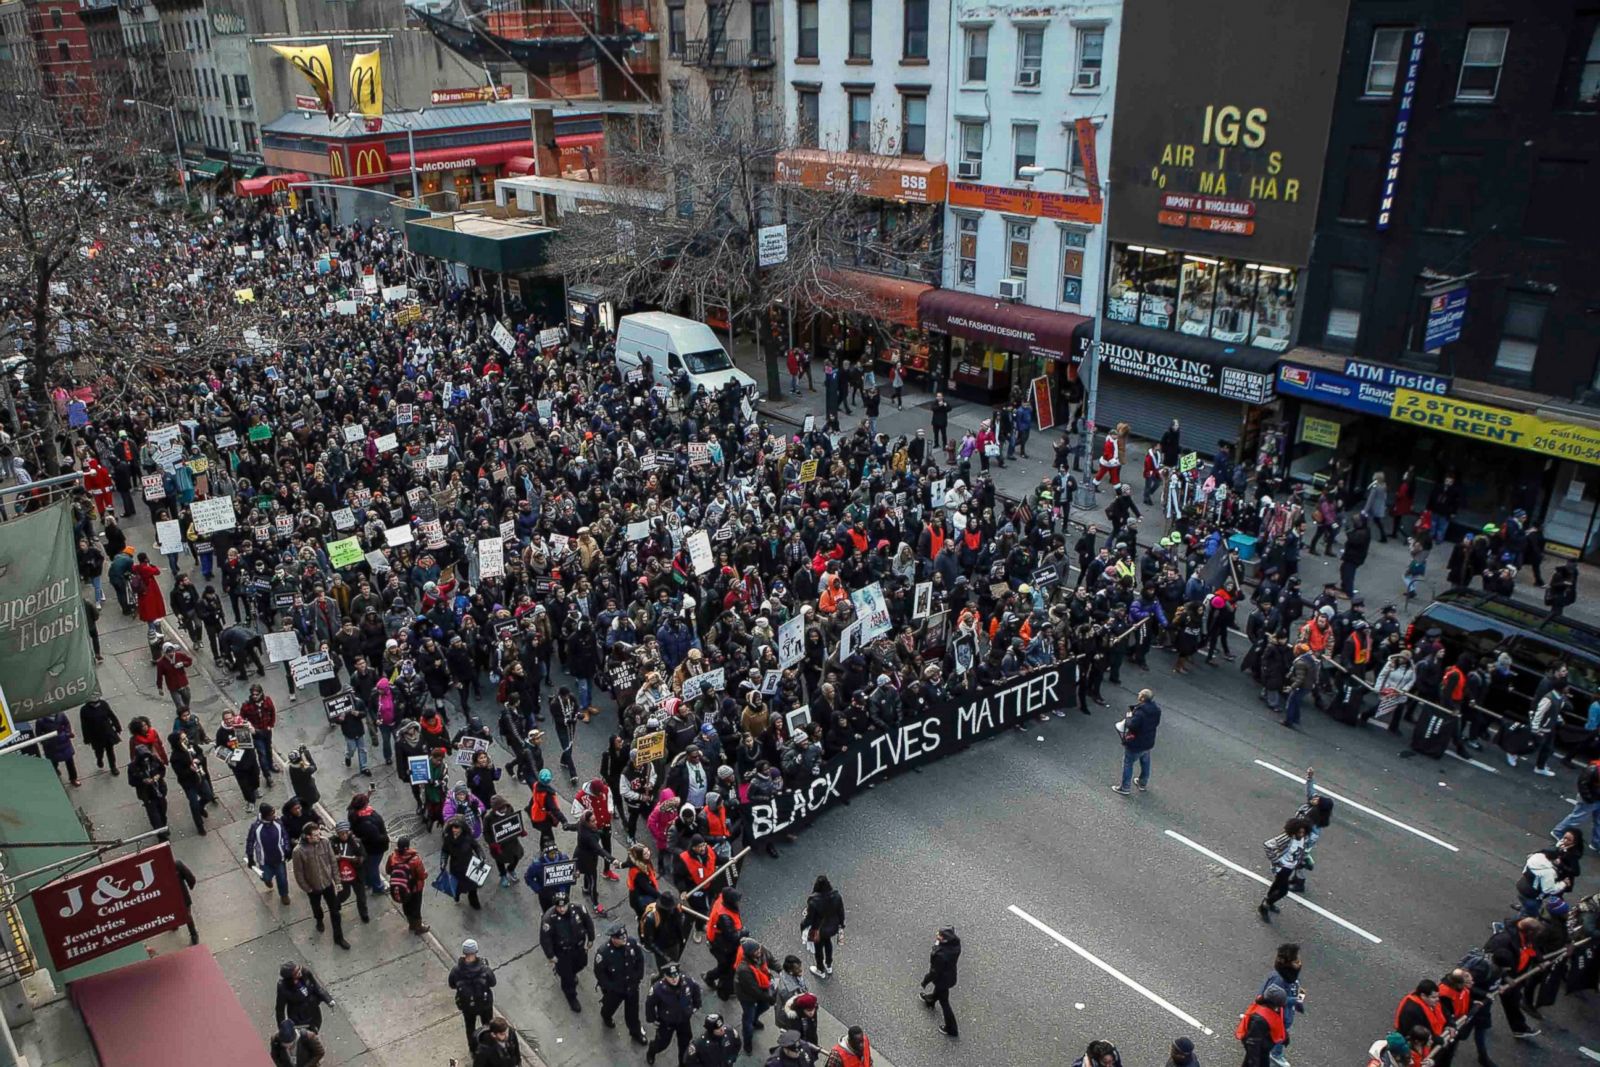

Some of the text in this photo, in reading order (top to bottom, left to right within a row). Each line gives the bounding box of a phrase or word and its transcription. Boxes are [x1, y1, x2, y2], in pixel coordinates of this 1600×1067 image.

[1401, 31, 1425, 109] CHECK
[1202, 104, 1268, 148] IGS
[422, 158, 477, 172] McDonald's
[1161, 144, 1195, 167] AIR
[901, 174, 927, 190] BSB
[1378, 121, 1407, 225] CASHING
[1165, 196, 1194, 208] IMPORT
[1205, 200, 1250, 214] WHOLESALE
[947, 316, 967, 326] AMICA
[968, 320, 996, 333] FASHION
[996, 325, 1022, 338] DESIGN
[1109, 357, 1150, 372] FASHION
[1152, 367, 1208, 385] HANDBAGS
[1146, 352, 1179, 371] BOX
[1180, 359, 1214, 378] INC.
[1225, 370, 1262, 385] KIKKO USA
[1225, 378, 1247, 387] IMPORT
[1345, 362, 1448, 395] ATM inside
[1359, 383, 1395, 400] Financ
[1407, 396, 1512, 427] 2 STORES
[1396, 406, 1524, 444] FOR RENT
[1550, 428, 1571, 439] Call
[1558, 443, 1600, 460] 410-54
[0, 577, 70, 629] uperior
[20, 607, 80, 652] Florist
[613, 673, 636, 687] JUSTICE
[617, 670, 629, 679] AND
[620, 681, 631, 690] FOR
[10, 676, 87, 715] 79-4065
[458, 751, 473, 761] JUS
[752, 670, 1060, 840] BLACK LIVES MATTER
[59, 859, 155, 918] J & J
[546, 875, 573, 884] ANYMORE
[97, 889, 161, 917] Collection
[62, 917, 126, 947] Jewelries
[66, 913, 176, 959] Hair Accessories
